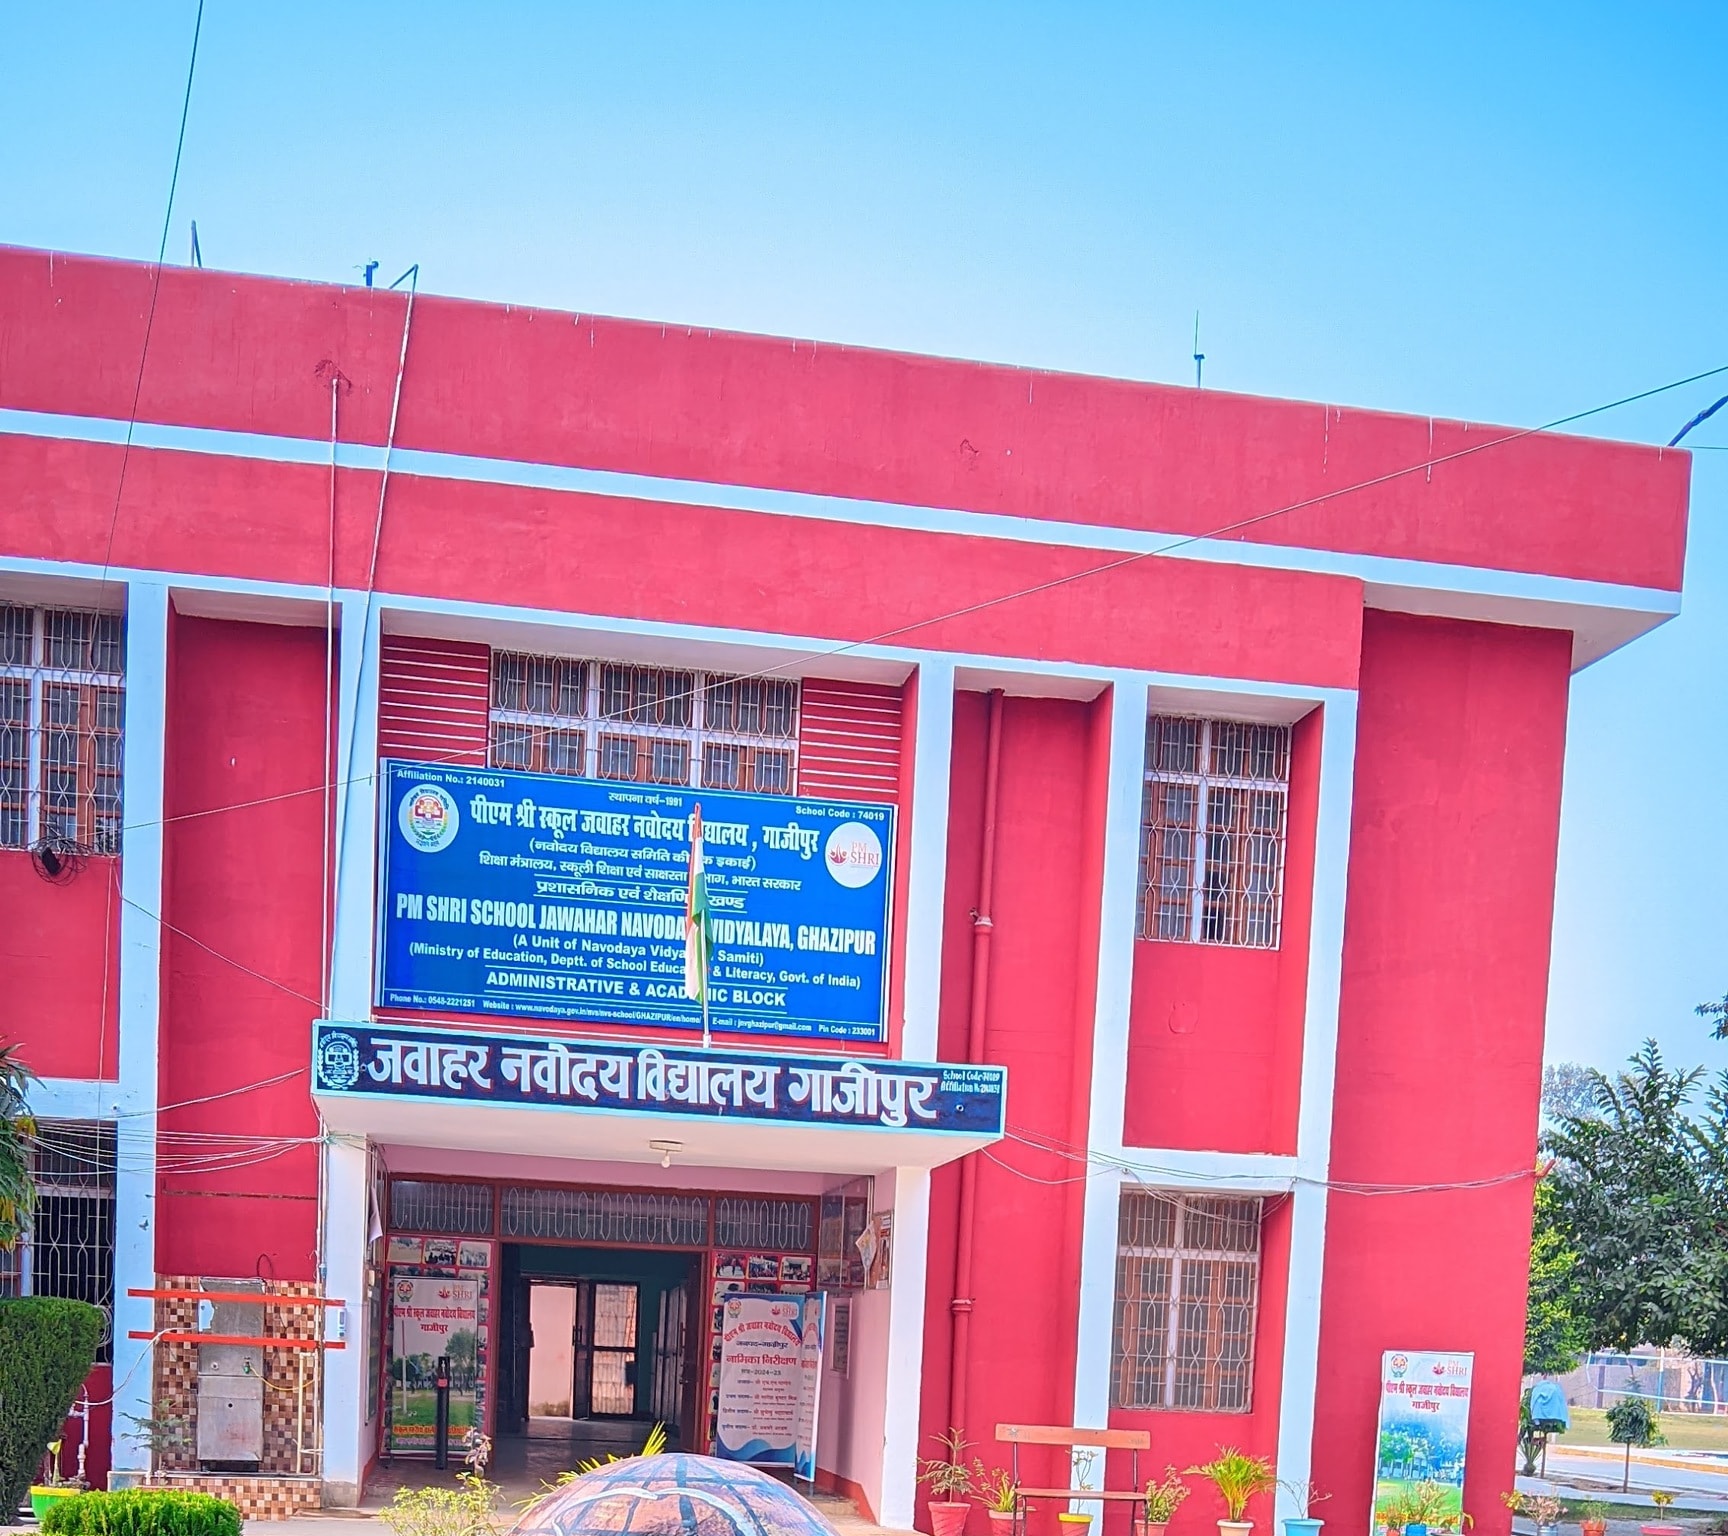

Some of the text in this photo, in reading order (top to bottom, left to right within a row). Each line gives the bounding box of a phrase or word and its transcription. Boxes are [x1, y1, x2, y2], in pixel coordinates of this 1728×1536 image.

[397, 770, 505, 788] Affiliation No.: 2140031
[608, 792, 643, 803] स्थापना
[796, 806, 825, 817] School
[828, 807, 850, 818] Code
[858, 810, 884, 821] 74019
[470, 794, 513, 826] पीएम
[515, 798, 536, 828] श्री
[538, 806, 578, 839] स्कूल
[580, 810, 631, 836] जवाहर
[633, 810, 686, 841] नवोदय
[762, 822, 820, 859] गाजीपुर
[529, 837, 578, 854] (नवोदय
[580, 842, 629, 858] विद्यालय
[631, 847, 671, 861] समिति
[716, 855, 756, 872] इकाई)
[852, 841, 867, 852] PM
[850, 851, 879, 865] SHRI
[479, 851, 508, 866] शिक्षा
[510, 854, 557, 871] मंत्रालय,
[560, 859, 594, 878] स्कूली
[596, 861, 624, 876] शिक्षा
[626, 865, 642, 878] एवं
[644, 868, 688, 881] साक्षरता
[732, 875, 761, 888] भारत
[762, 878, 801, 891] सरकार
[535, 881, 616, 898] प्रशासनिक
[618, 886, 641, 899] एवं
[397, 893, 423, 920] PM
[426, 896, 467, 923] SHRI
[470, 900, 536, 929] SCHOOL
[539, 904, 617, 936] JAWAHAR
[621, 910, 686, 940] NAVODA
[797, 926, 876, 955] GHAZIPUR
[513, 934, 527, 948] (A
[532, 935, 560, 949] Unit
[563, 937, 578, 950] of
[581, 939, 646, 958] Navodaya
[717, 950, 764, 967] Samiti)
[409, 941, 463, 960] (Ministry
[467, 947, 480, 959] of
[483, 947, 547, 966] Education,
[551, 955, 588, 968] Deptt.
[591, 957, 603, 967] of
[606, 957, 647, 971] School
[713, 965, 721, 977] &
[726, 967, 776, 983] Literacy,
[779, 970, 810, 984] Govt.
[813, 973, 824, 985] of
[828, 973, 861, 989] India)
[486, 971, 624, 996] ADMINISTRATIVE
[629, 982, 640, 995] &
[732, 990, 786, 1007] BLOCK
[389, 993, 411, 1003] Phone
[428, 995, 476, 1008] 0548-2221251
[482, 1000, 510, 1010] Website
[712, 1017, 733, 1027] E-mail
[818, 1024, 830, 1033] Pin
[831, 1025, 847, 1034] Code
[851, 1027, 876, 1037] 233001
[367, 1037, 938, 1128] जवाहर नवोदय विद्यालय गाजीपुर
[943, 1070, 965, 1080] School
[1446, 1366, 1468, 1377] SHRI
